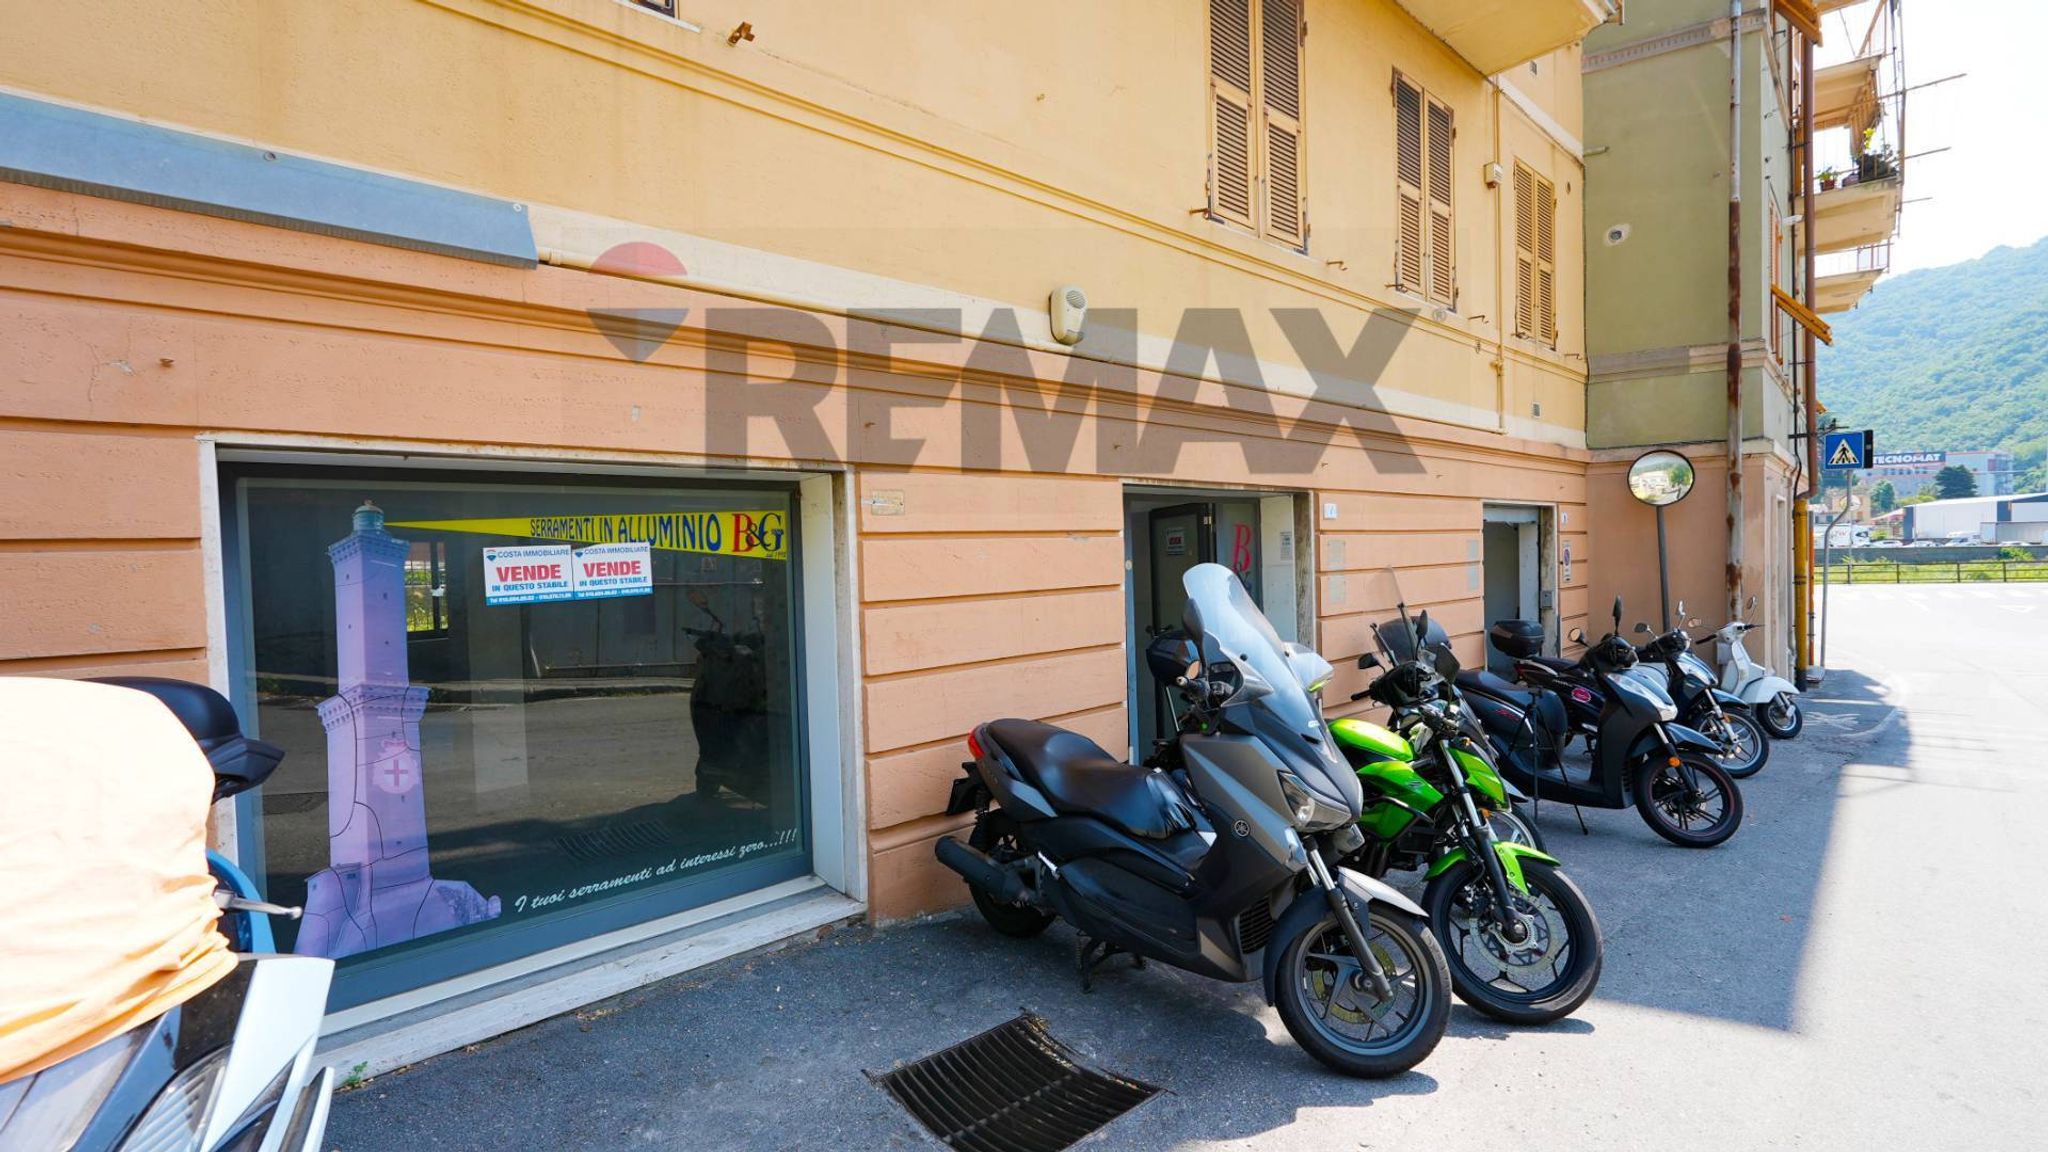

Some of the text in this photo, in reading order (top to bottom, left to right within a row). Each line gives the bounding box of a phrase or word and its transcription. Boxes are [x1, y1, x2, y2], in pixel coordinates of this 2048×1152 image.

[1873, 453, 1941, 464] TECNOMAT
[530, 512, 784, 552] SERRAMENTI IN ALLUMINIO B&G
[523, 549, 570, 557] IMMOBILIARE
[584, 547, 605, 555] COSTA
[496, 564, 562, 582] VENDE
[583, 560, 641, 578] VENDE
[491, 581, 569, 592] IN QUESTO STABILE
[589, 578, 618, 587] QUESTO
[619, 576, 648, 585] STABILE
[531, 889, 565, 909] tuoi
[568, 867, 652, 899] serramenti
[655, 861, 676, 876] ad
[680, 846, 735, 869] interessi
